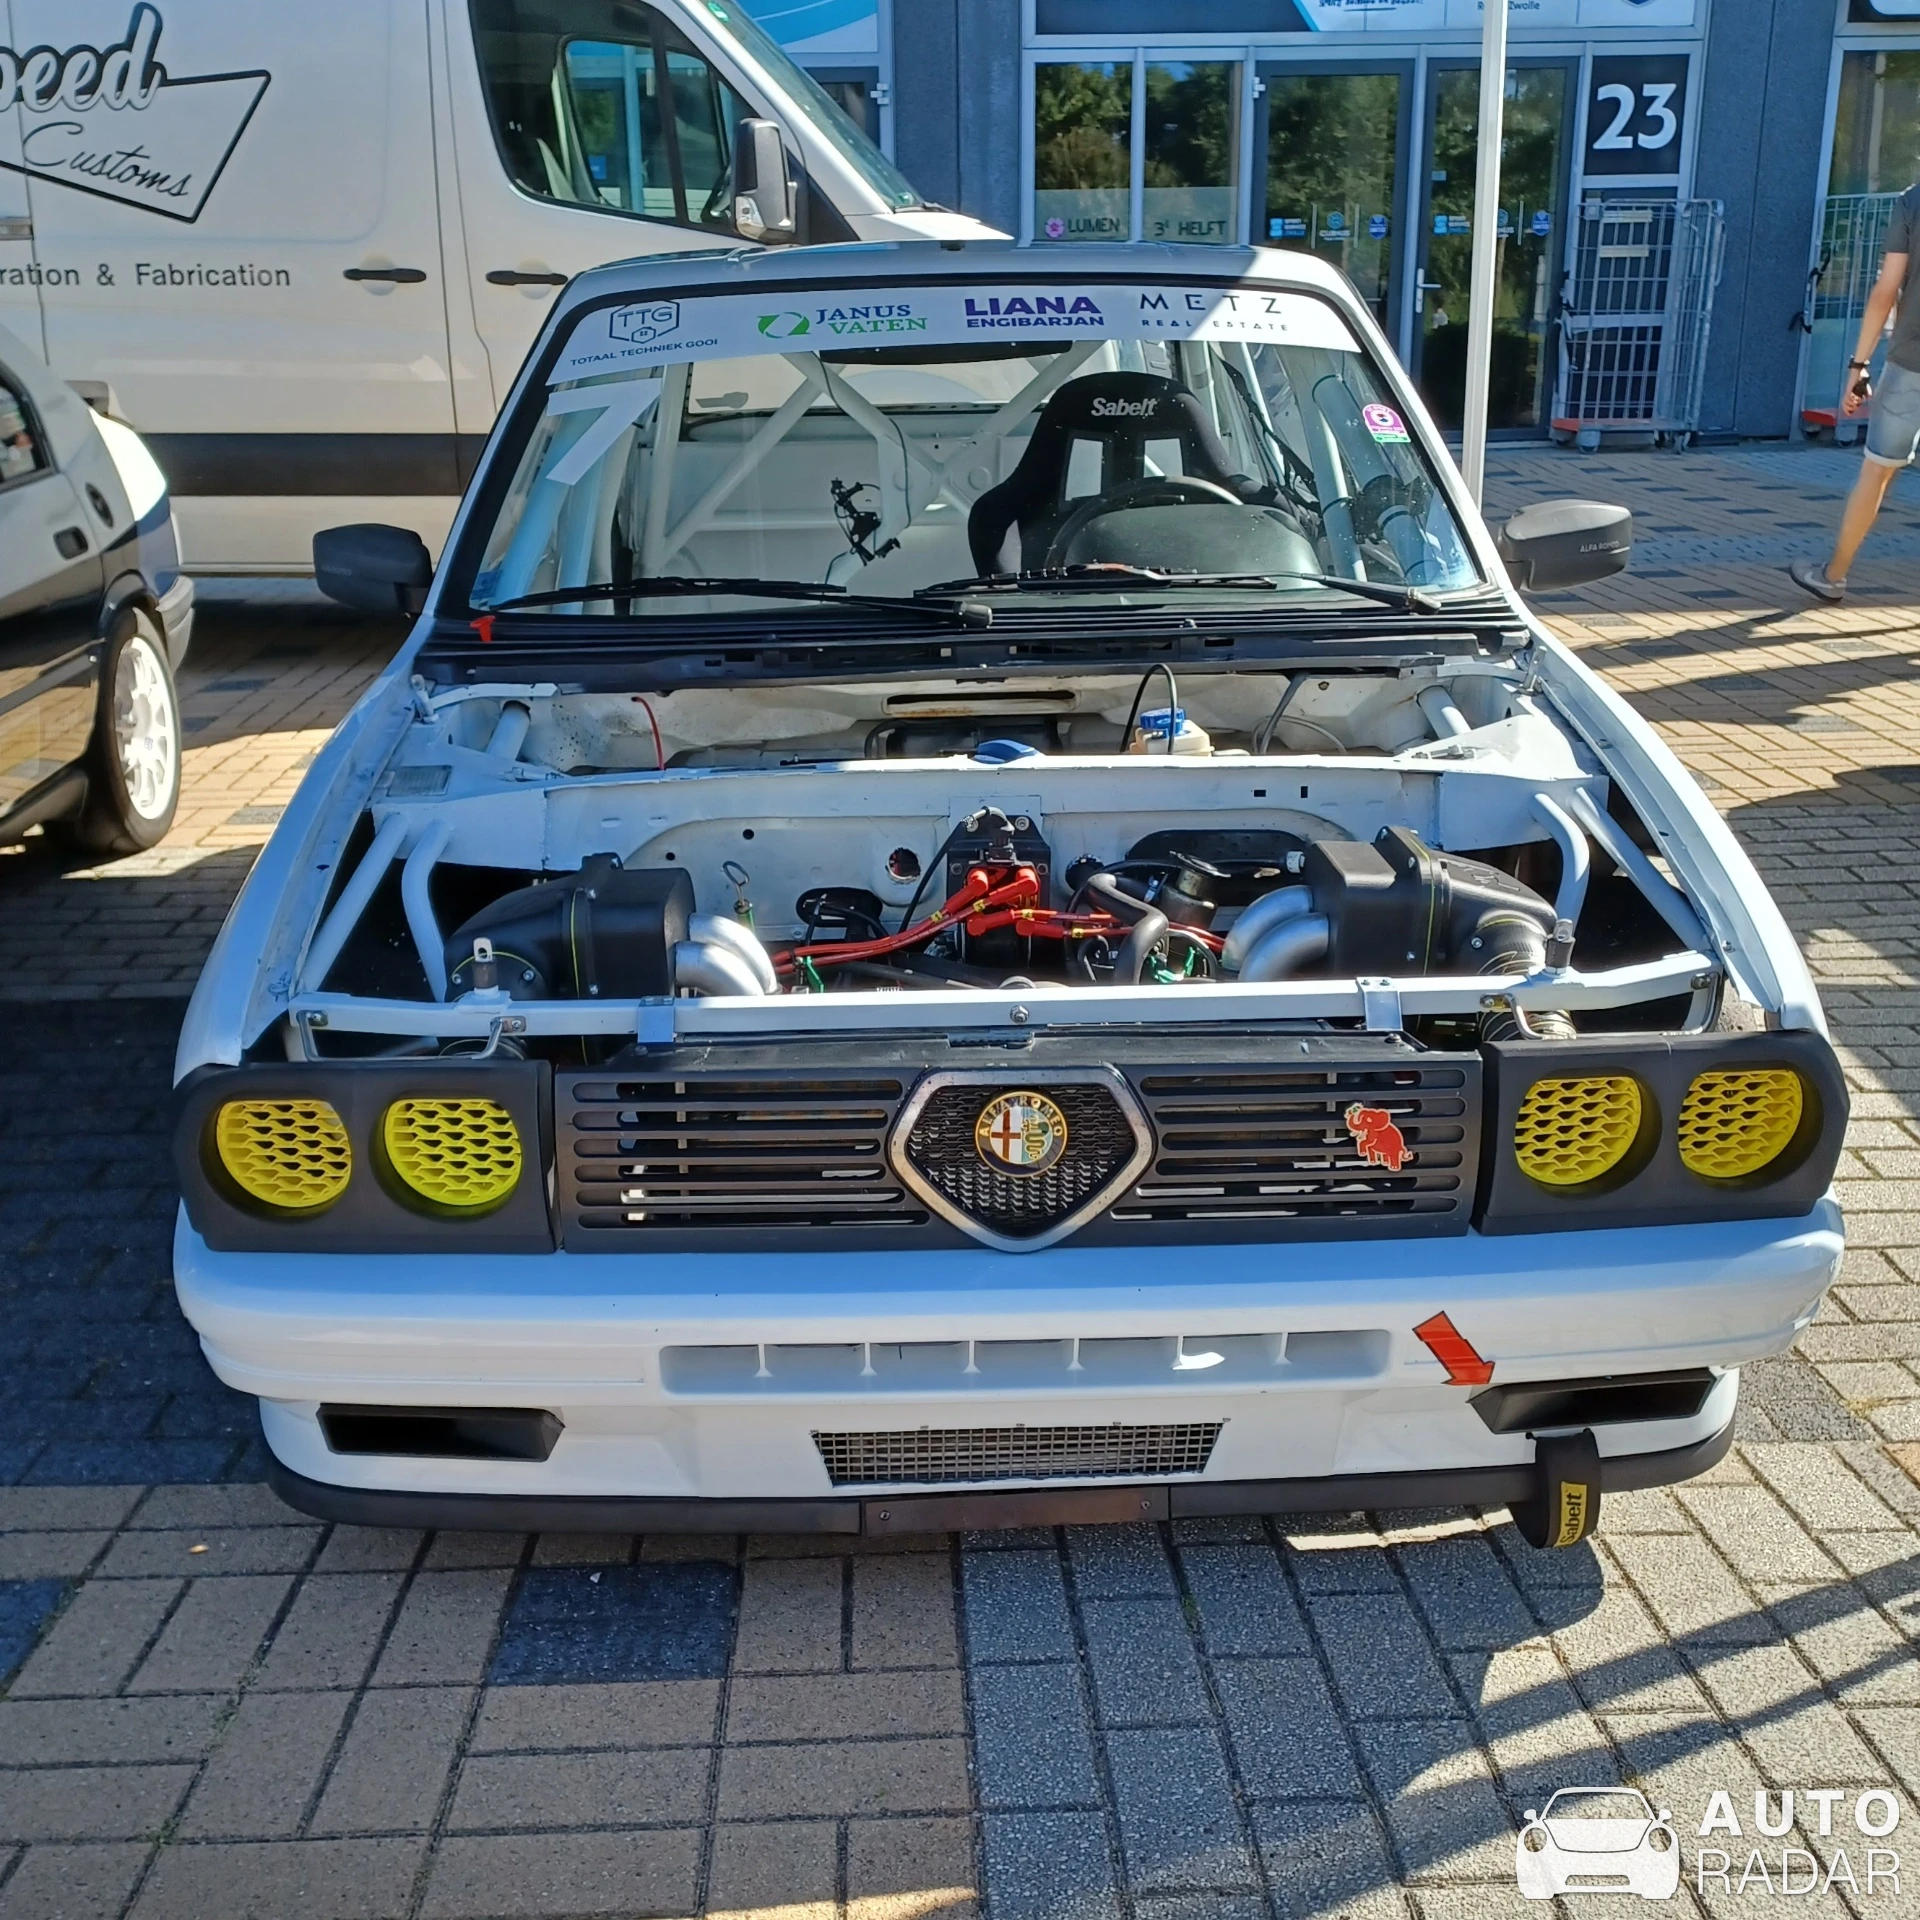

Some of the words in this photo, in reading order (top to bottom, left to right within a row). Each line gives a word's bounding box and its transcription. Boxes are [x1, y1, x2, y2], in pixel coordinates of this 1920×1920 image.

[1593, 83, 1677, 149] 23
[22, 121, 193, 197] Customs
[1067, 217, 1121, 233] LUMEN
[1178, 220, 1227, 236] HELFT
[97, 263, 115, 286] &
[136, 263, 290, 287] Fabrication
[964, 296, 1102, 316] LIANA
[1140, 293, 1281, 314] METZ
[617, 306, 673, 328] TTG
[816, 304, 911, 324] JANUS
[966, 316, 1105, 328] ENGIBARJAN
[828, 317, 928, 335] VATEN
[1142, 319, 1193, 327] REAL
[1213, 320, 1288, 332] ESTATE
[571, 352, 617, 366] TOTAAL
[620, 342, 683, 357] TECHNIEK
[685, 338, 718, 349] GOOI
[1091, 397, 1158, 417] Sabelt
[1580, 544, 1597, 553] ALFA
[1599, 541, 1619, 550] ROMEO
[979, 1099, 1010, 1137] ALFA
[1019, 1096, 1064, 1137] ROMEO
[1560, 1492, 1582, 1543] Sabelt
